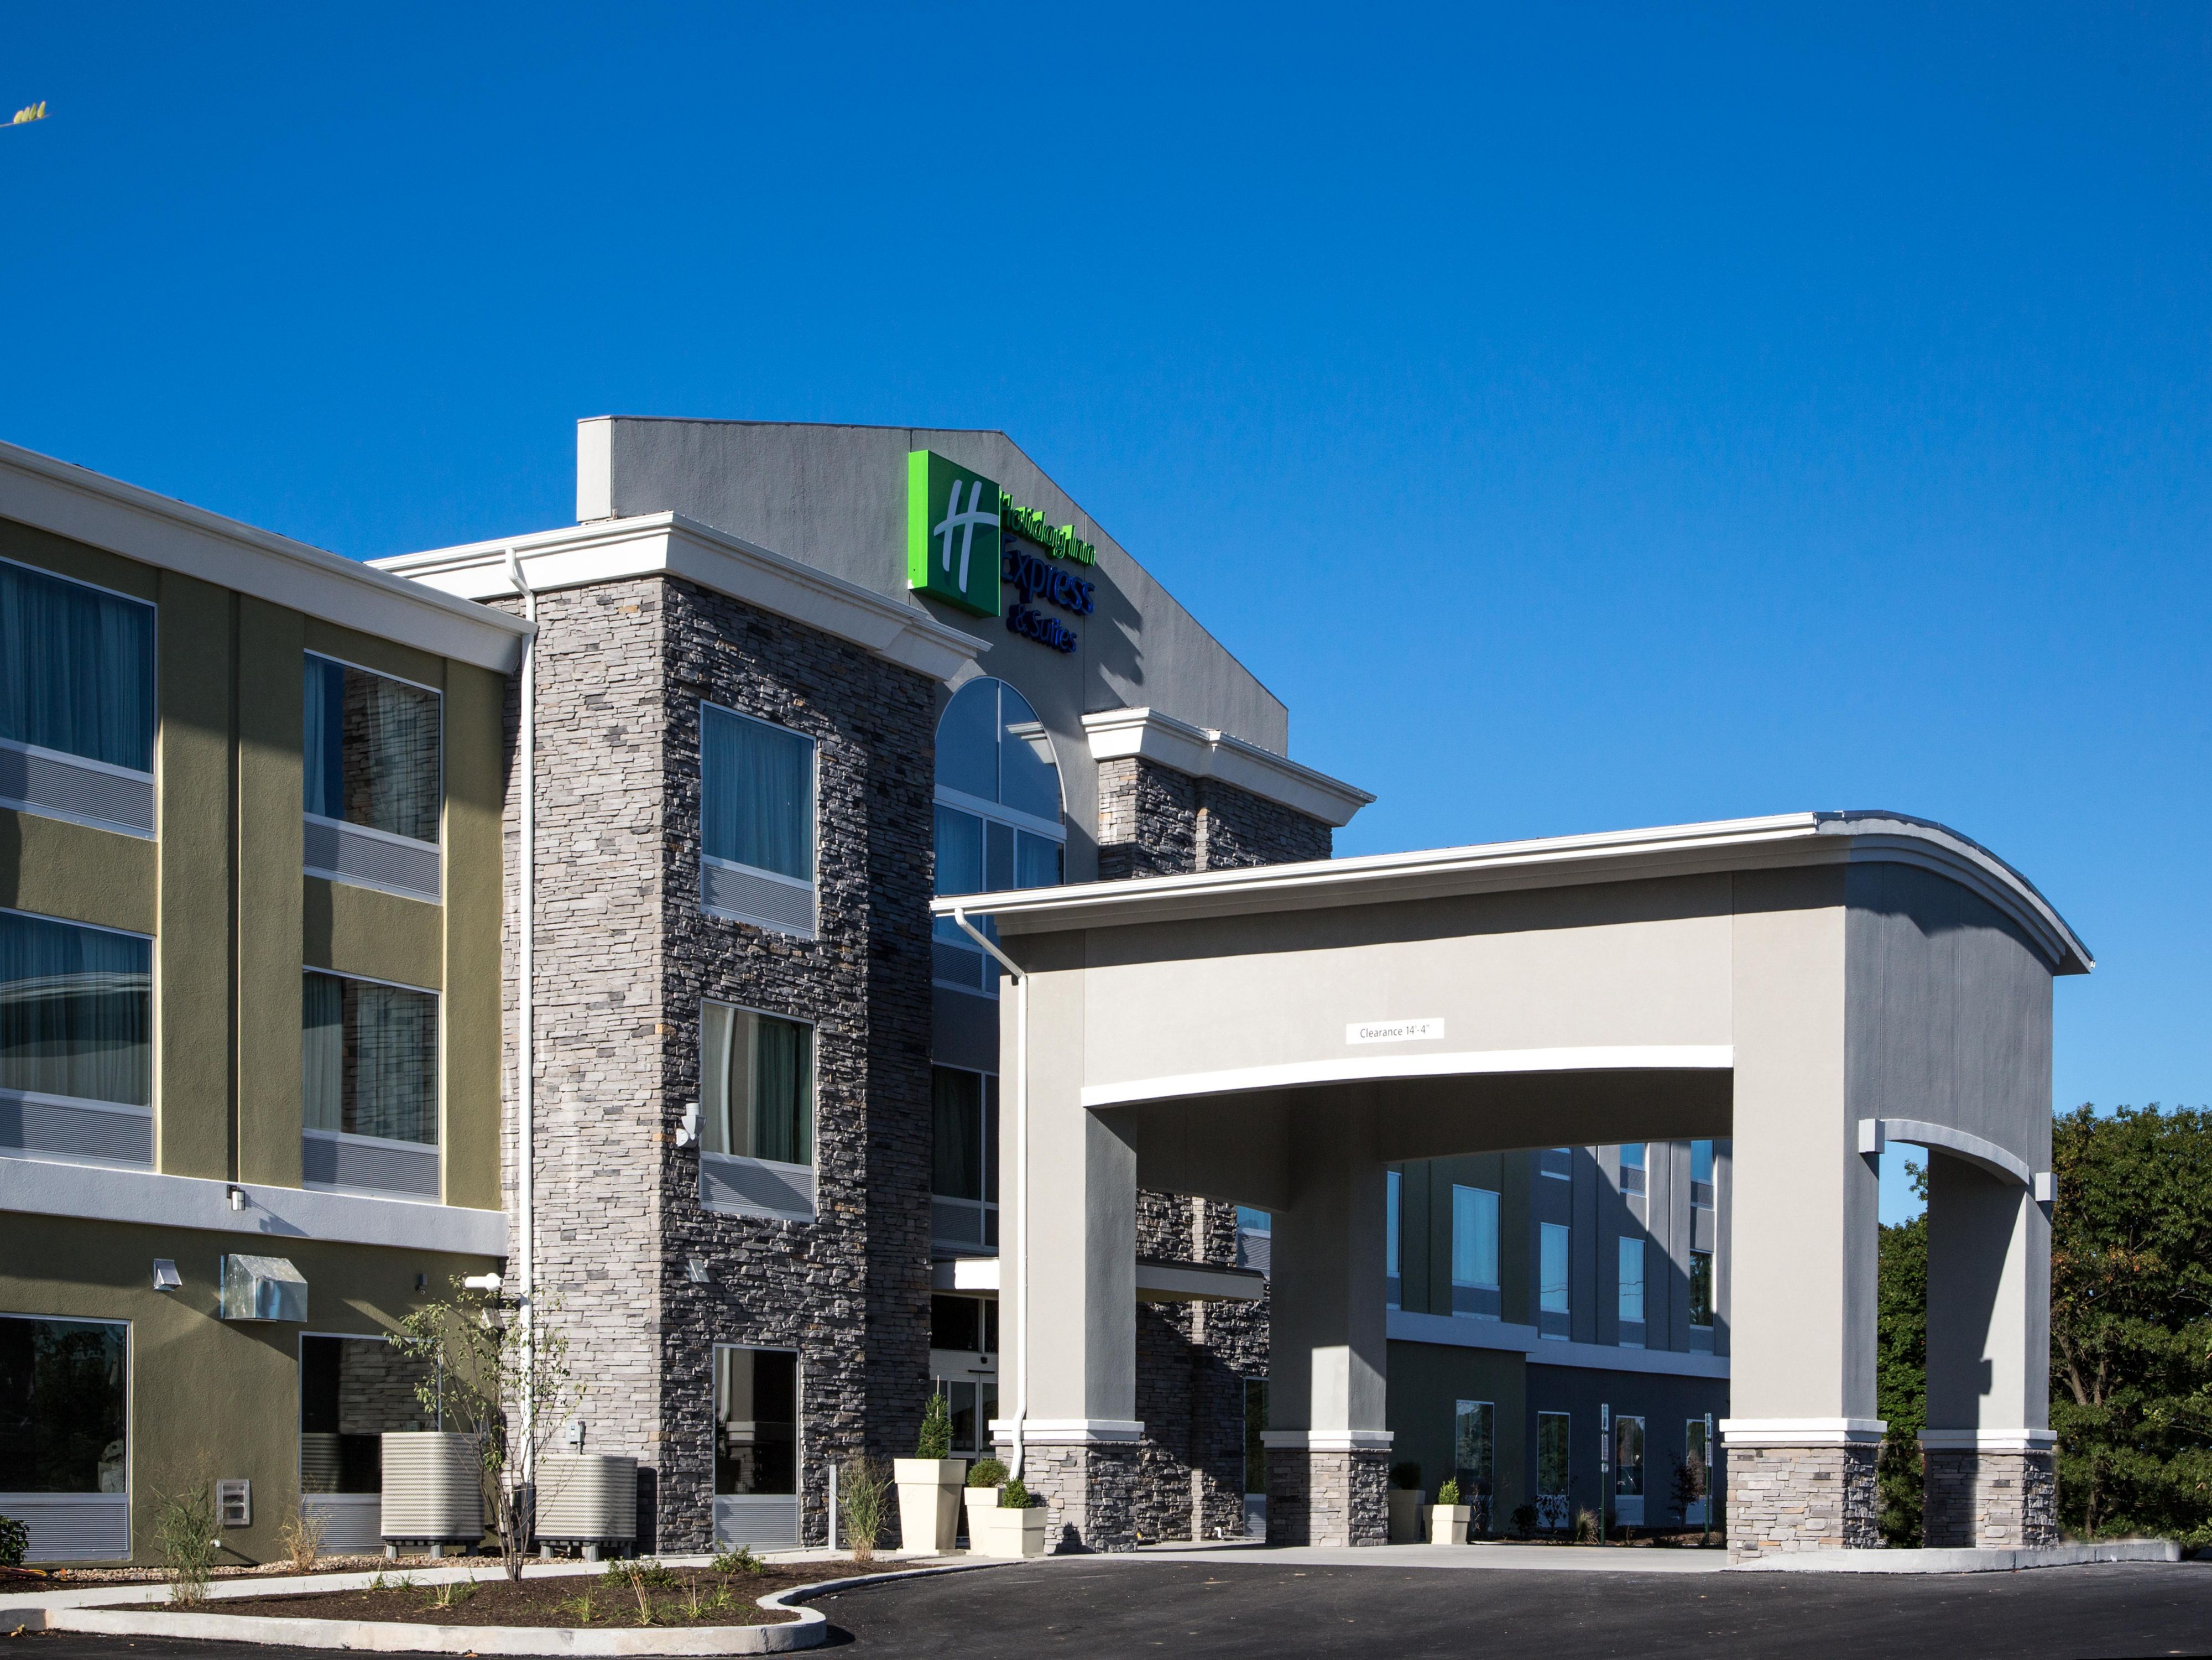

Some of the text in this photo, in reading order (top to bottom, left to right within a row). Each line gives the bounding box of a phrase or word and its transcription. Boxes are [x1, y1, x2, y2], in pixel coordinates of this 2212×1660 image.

[999, 490, 1096, 565] Holiday Inn
[1000, 532, 1097, 616] Express
[1011, 603, 1027, 632] &
[1360, 1028, 1403, 1038] Clearance
